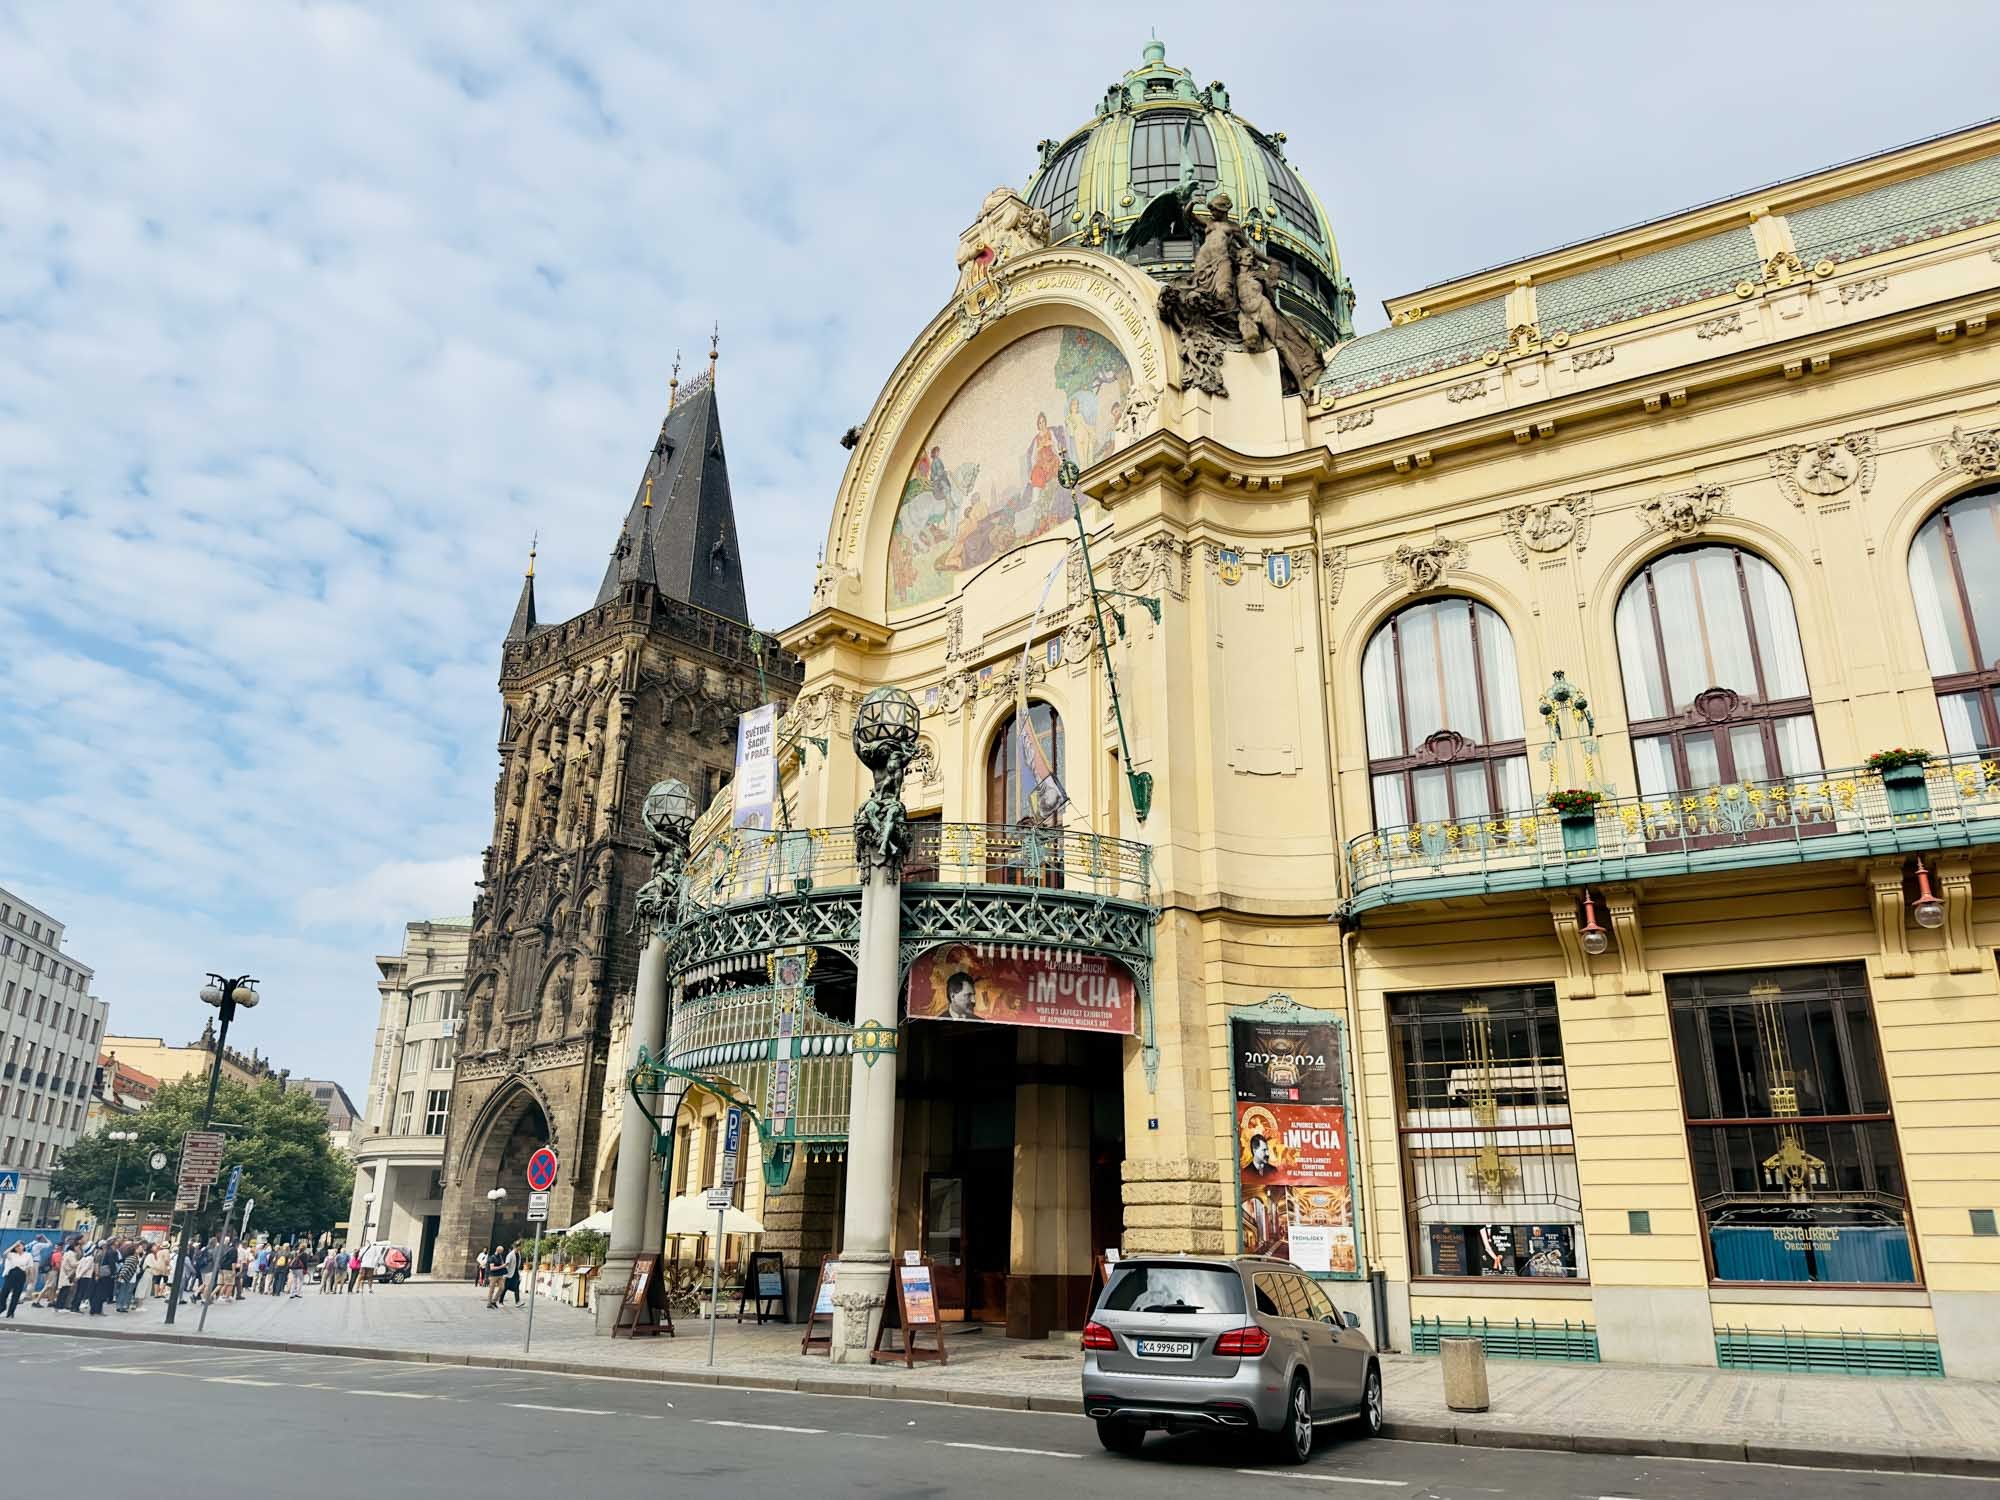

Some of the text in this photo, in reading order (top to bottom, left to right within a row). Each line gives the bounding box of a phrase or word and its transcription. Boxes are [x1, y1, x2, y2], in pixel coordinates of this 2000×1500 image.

[745, 722, 771, 739] SVĚTOVÉ
[1772, 1226, 1840, 1241] RESTAURACE
[1143, 1342, 1189, 1353] KA 9996 PP
